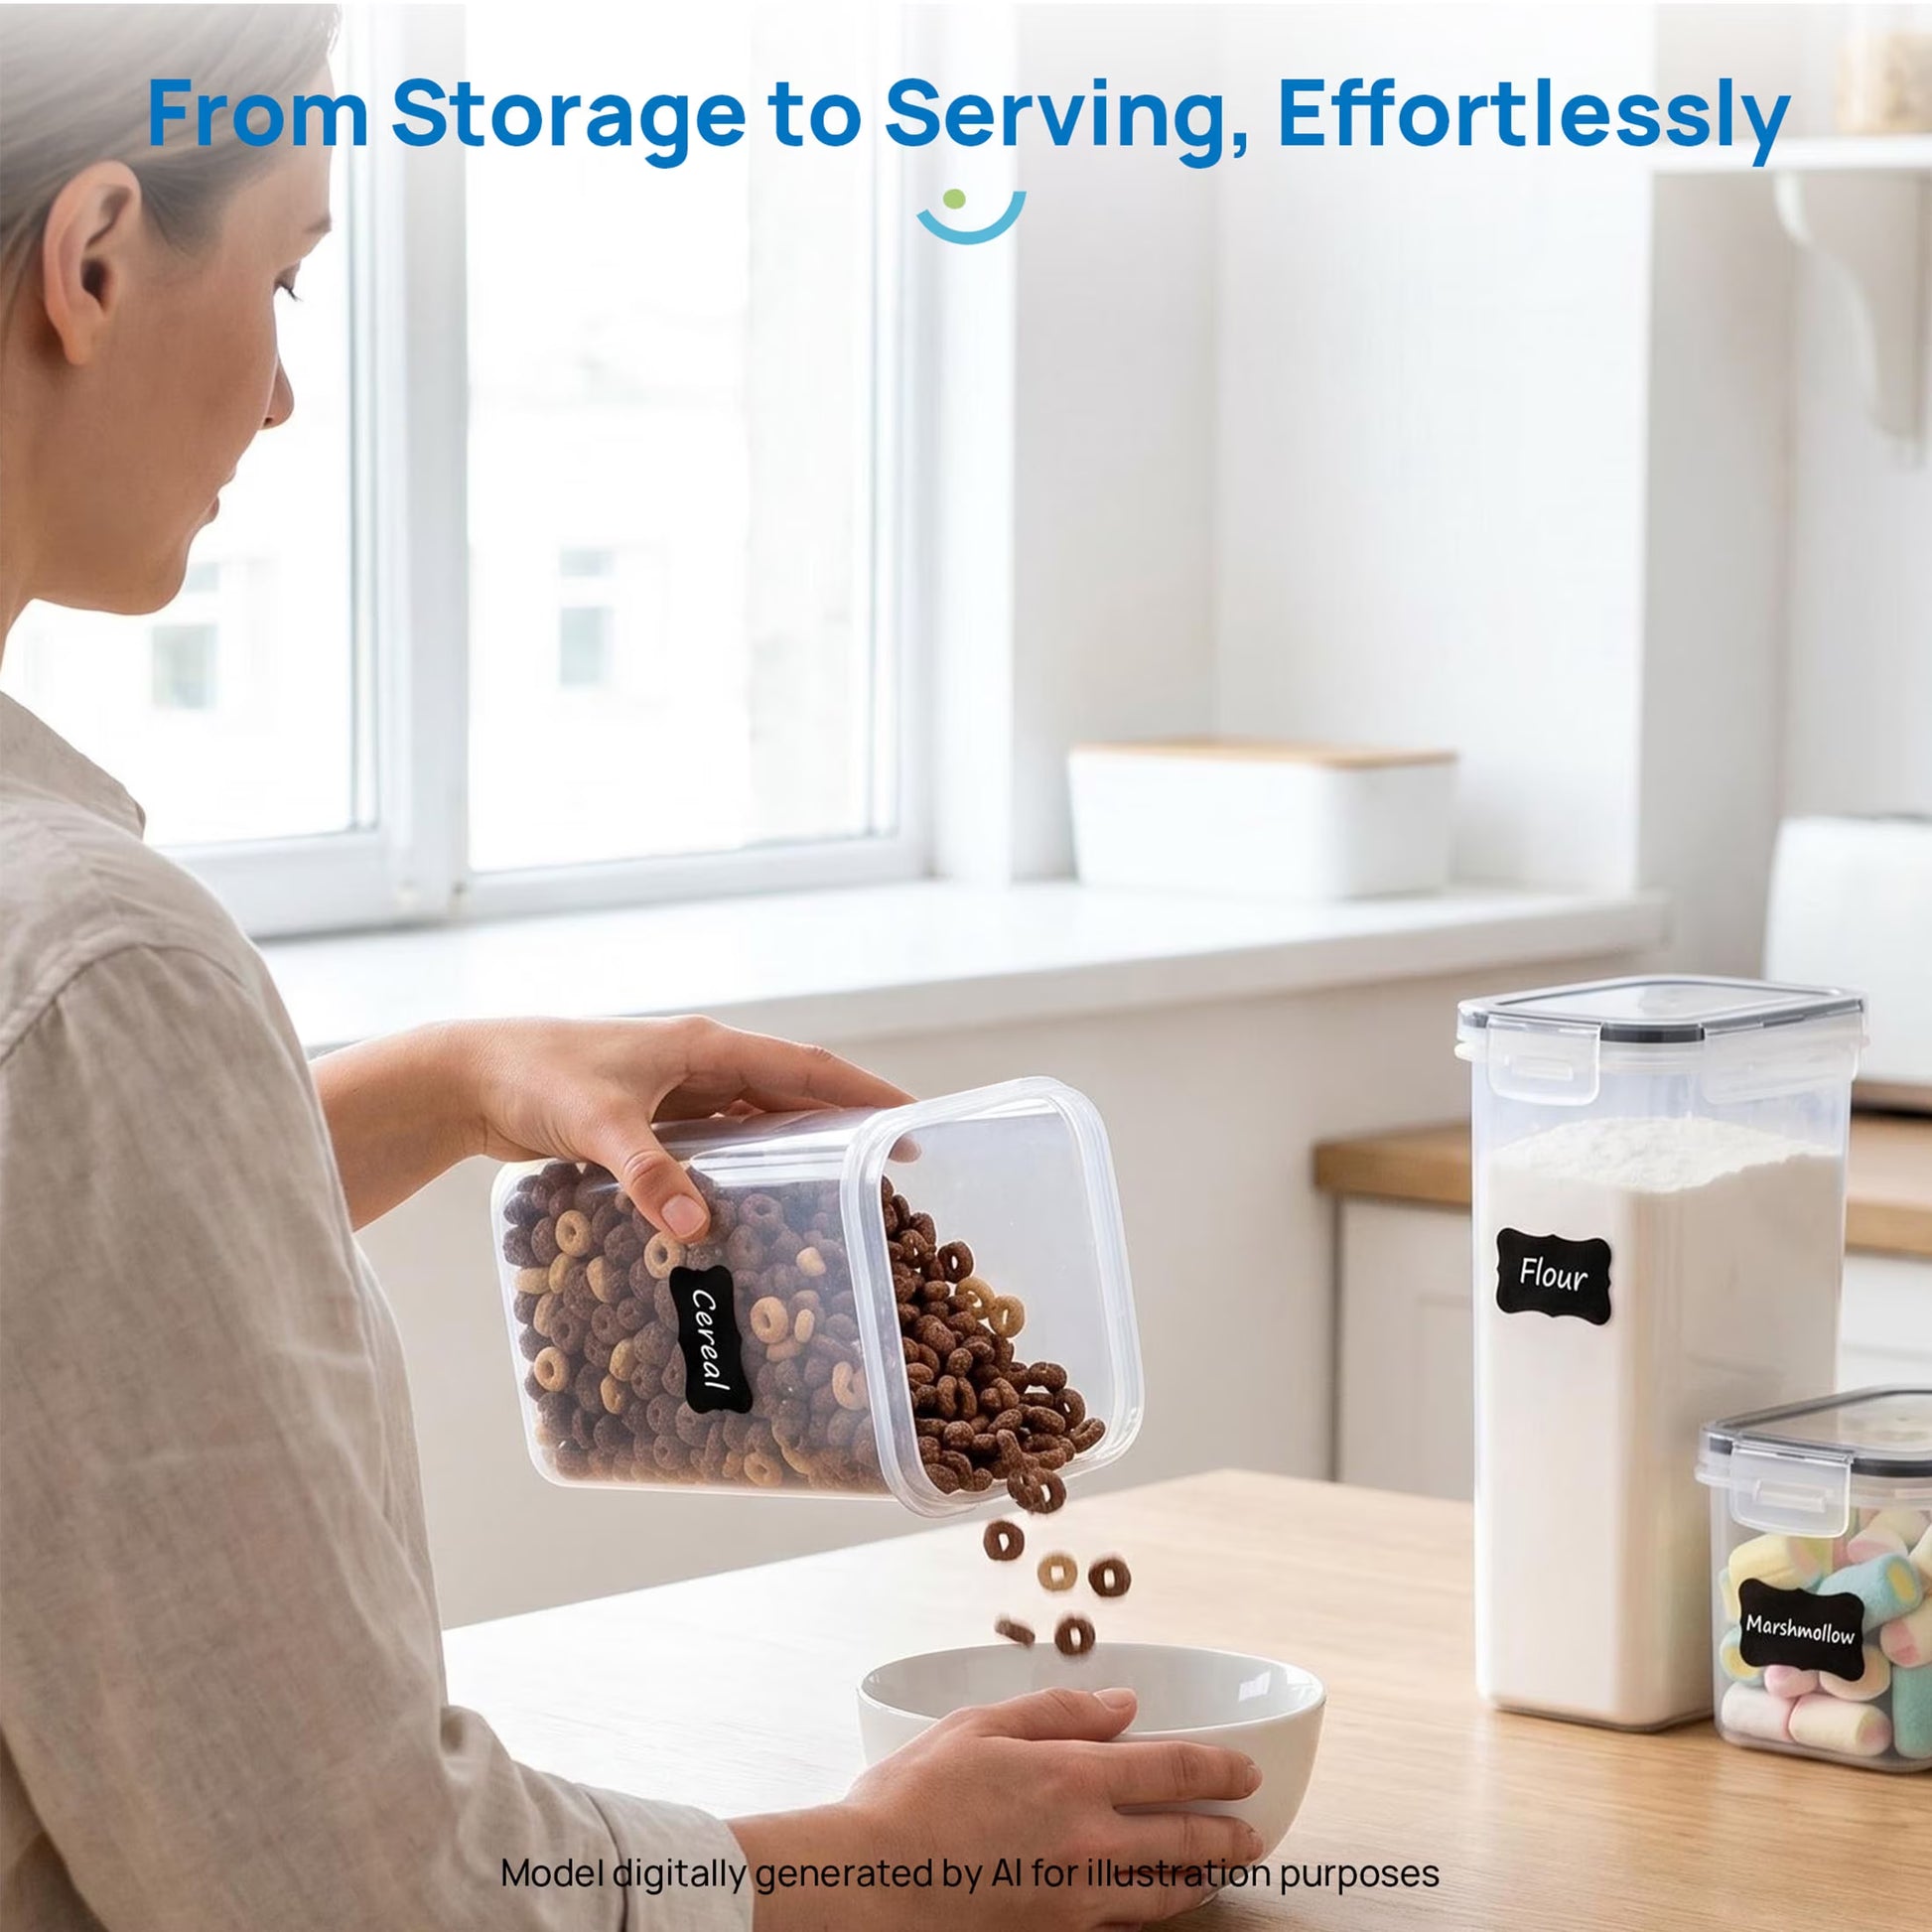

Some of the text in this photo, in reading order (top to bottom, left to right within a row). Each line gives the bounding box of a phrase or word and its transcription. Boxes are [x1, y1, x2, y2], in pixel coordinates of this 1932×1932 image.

[1520, 1256, 1588, 1292] Flour
[692, 1289, 731, 1391] Cereal
[1745, 1613, 1856, 1645] Marshmollow
